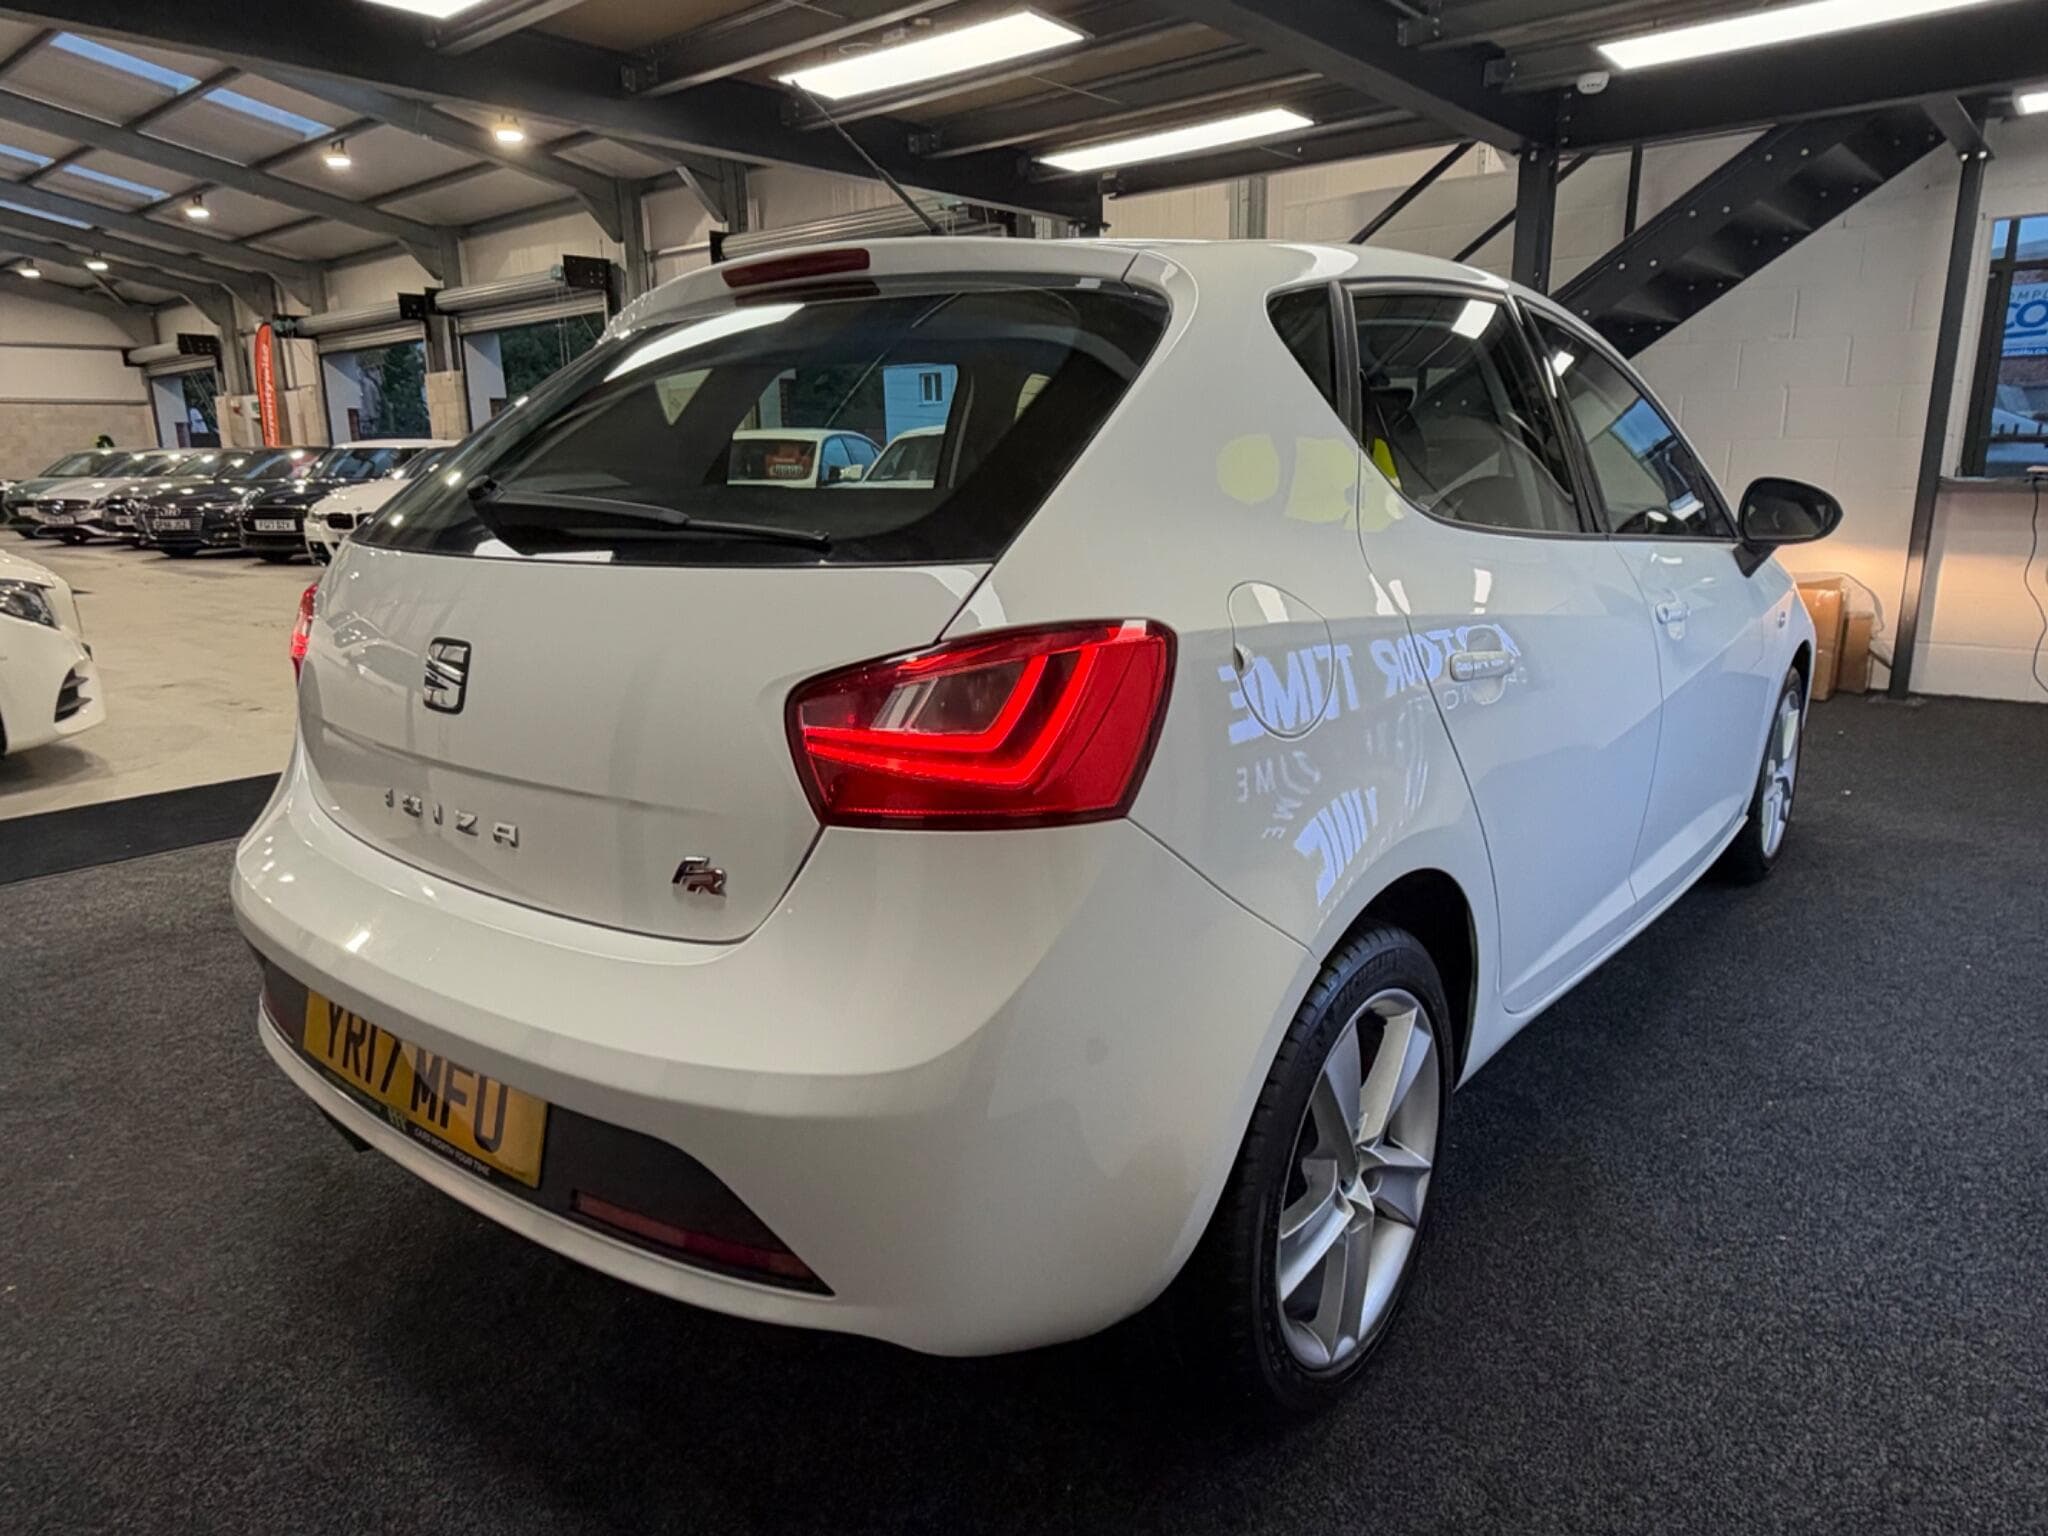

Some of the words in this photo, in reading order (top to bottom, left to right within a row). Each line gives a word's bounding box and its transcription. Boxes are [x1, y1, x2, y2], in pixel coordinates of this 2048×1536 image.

[384, 787, 519, 847] IBIZA
[328, 1000, 403, 1095] YR17
[410, 1046, 510, 1153] MFU
